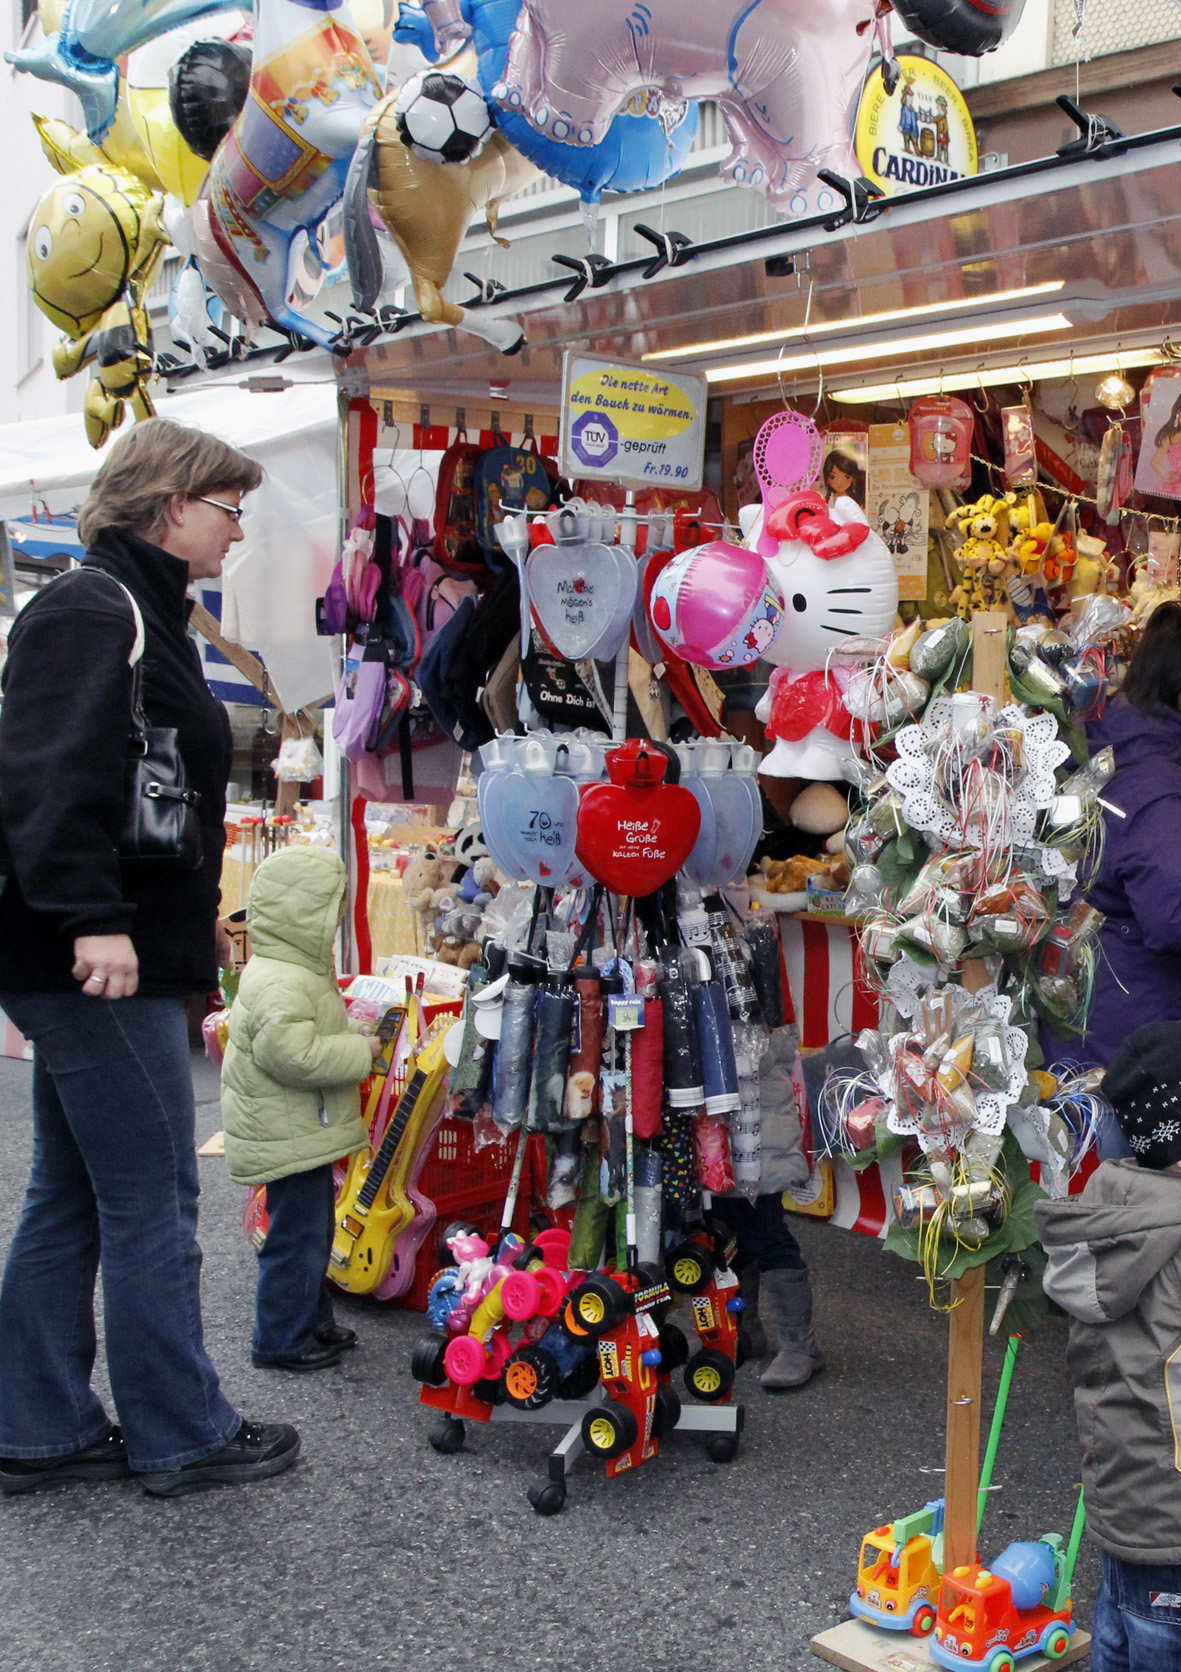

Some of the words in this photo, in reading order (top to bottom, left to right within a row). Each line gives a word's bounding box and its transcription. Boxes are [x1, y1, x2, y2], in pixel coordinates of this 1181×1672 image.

[869, 94, 885, 136] BIERE
[961, 118, 975, 162] BIRRA
[601, 374, 618, 388] Die
[621, 379, 649, 393] nette
[652, 383, 669, 397] Art
[571, 391, 592, 405] den
[595, 394, 630, 411] Bauch
[632, 403, 645, 413] zu
[648, 403, 693, 420] wärmen.
[585, 429, 606, 444] TÜV
[643, 462, 689, 478] Fr.19.90
[540, 690, 563, 704] Ohne
[565, 693, 584, 707] Dich
[529, 810, 552, 830] 70
[617, 820, 649, 832] Heiße
[539, 830, 561, 847] heiß
[625, 832, 658, 844] Grüße
[697, 1307, 709, 1329] HOT
[603, 1352, 614, 1377] HOT
